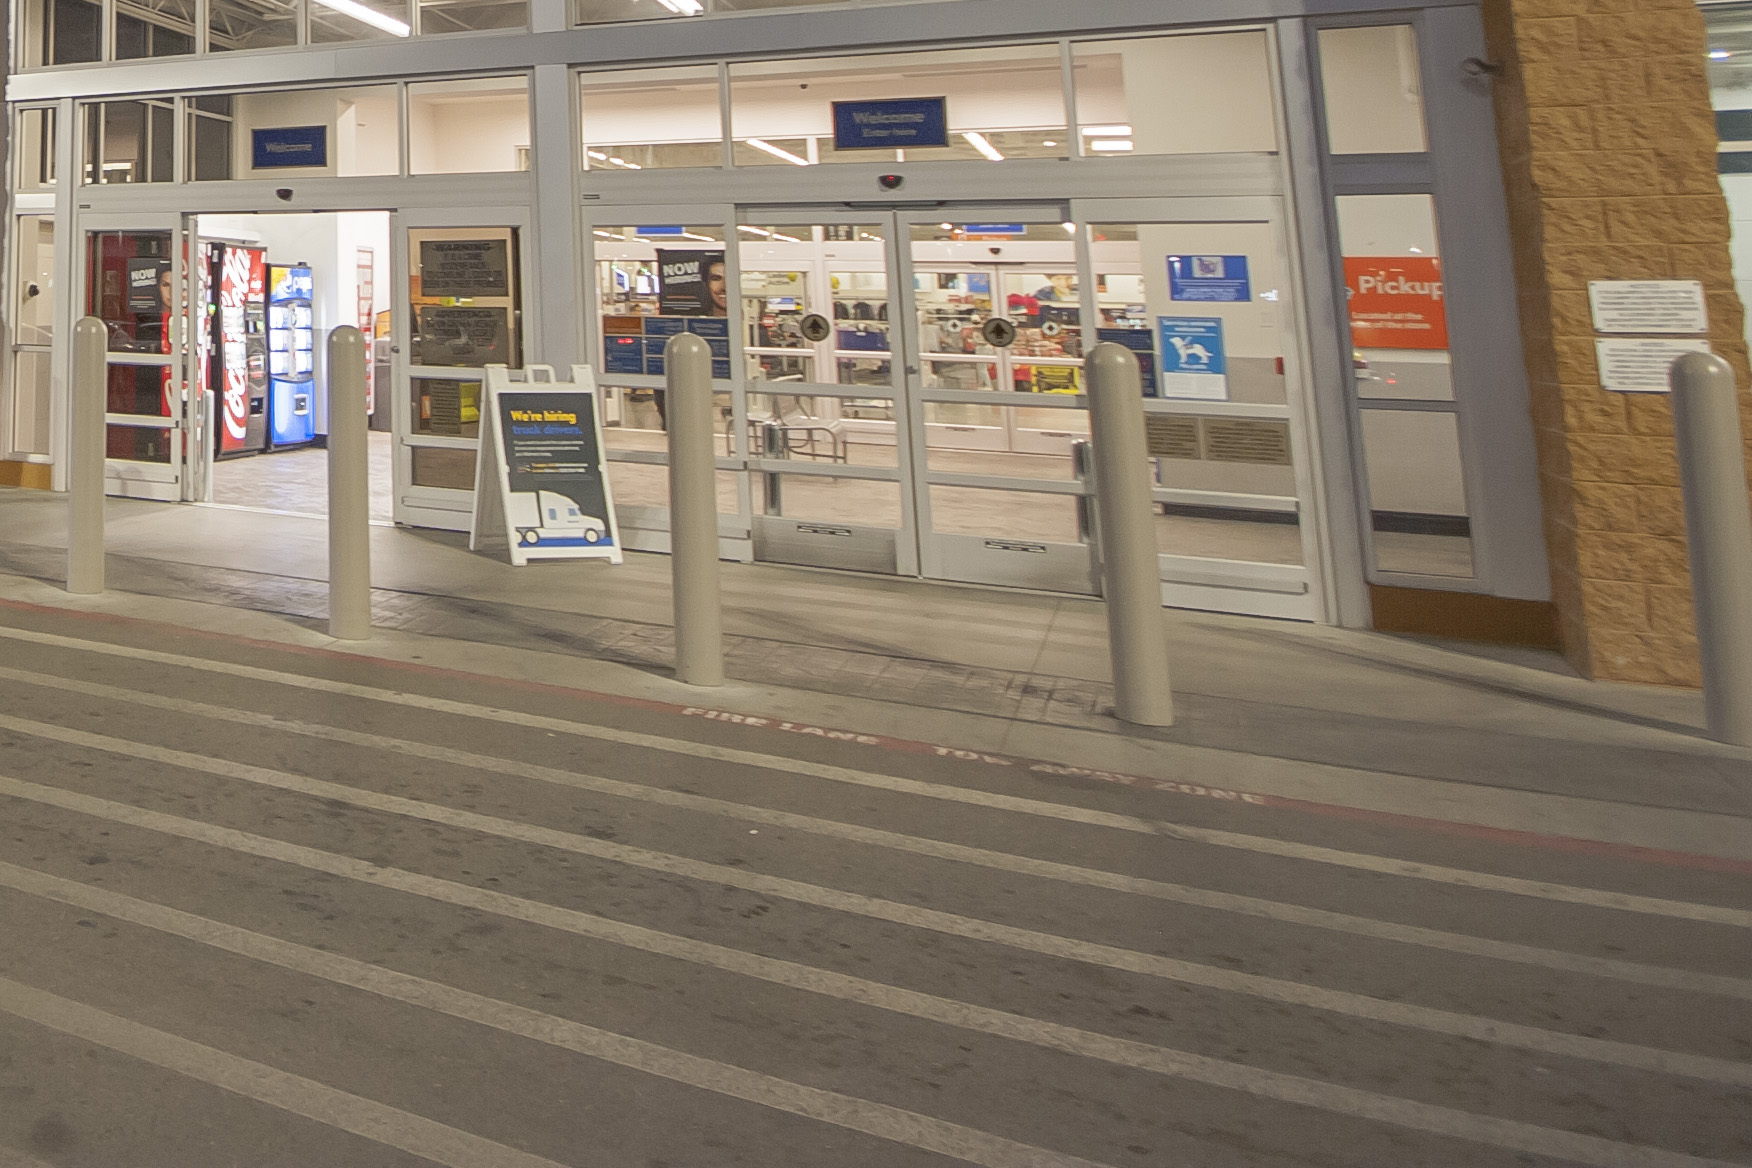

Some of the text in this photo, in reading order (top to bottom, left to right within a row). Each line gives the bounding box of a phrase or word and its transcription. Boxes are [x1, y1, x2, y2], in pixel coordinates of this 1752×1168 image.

[852, 111, 925, 124] Welcome
[131, 268, 156, 280] NOW
[662, 261, 700, 276] NOW
[1358, 275, 1443, 300] Pickup
[510, 410, 577, 424] We're hiring
[681, 707, 769, 727] FIRE
[778, 722, 879, 745] LANE
[932, 745, 1012, 766] TOW
[1155, 782, 1264, 805] ZONE
